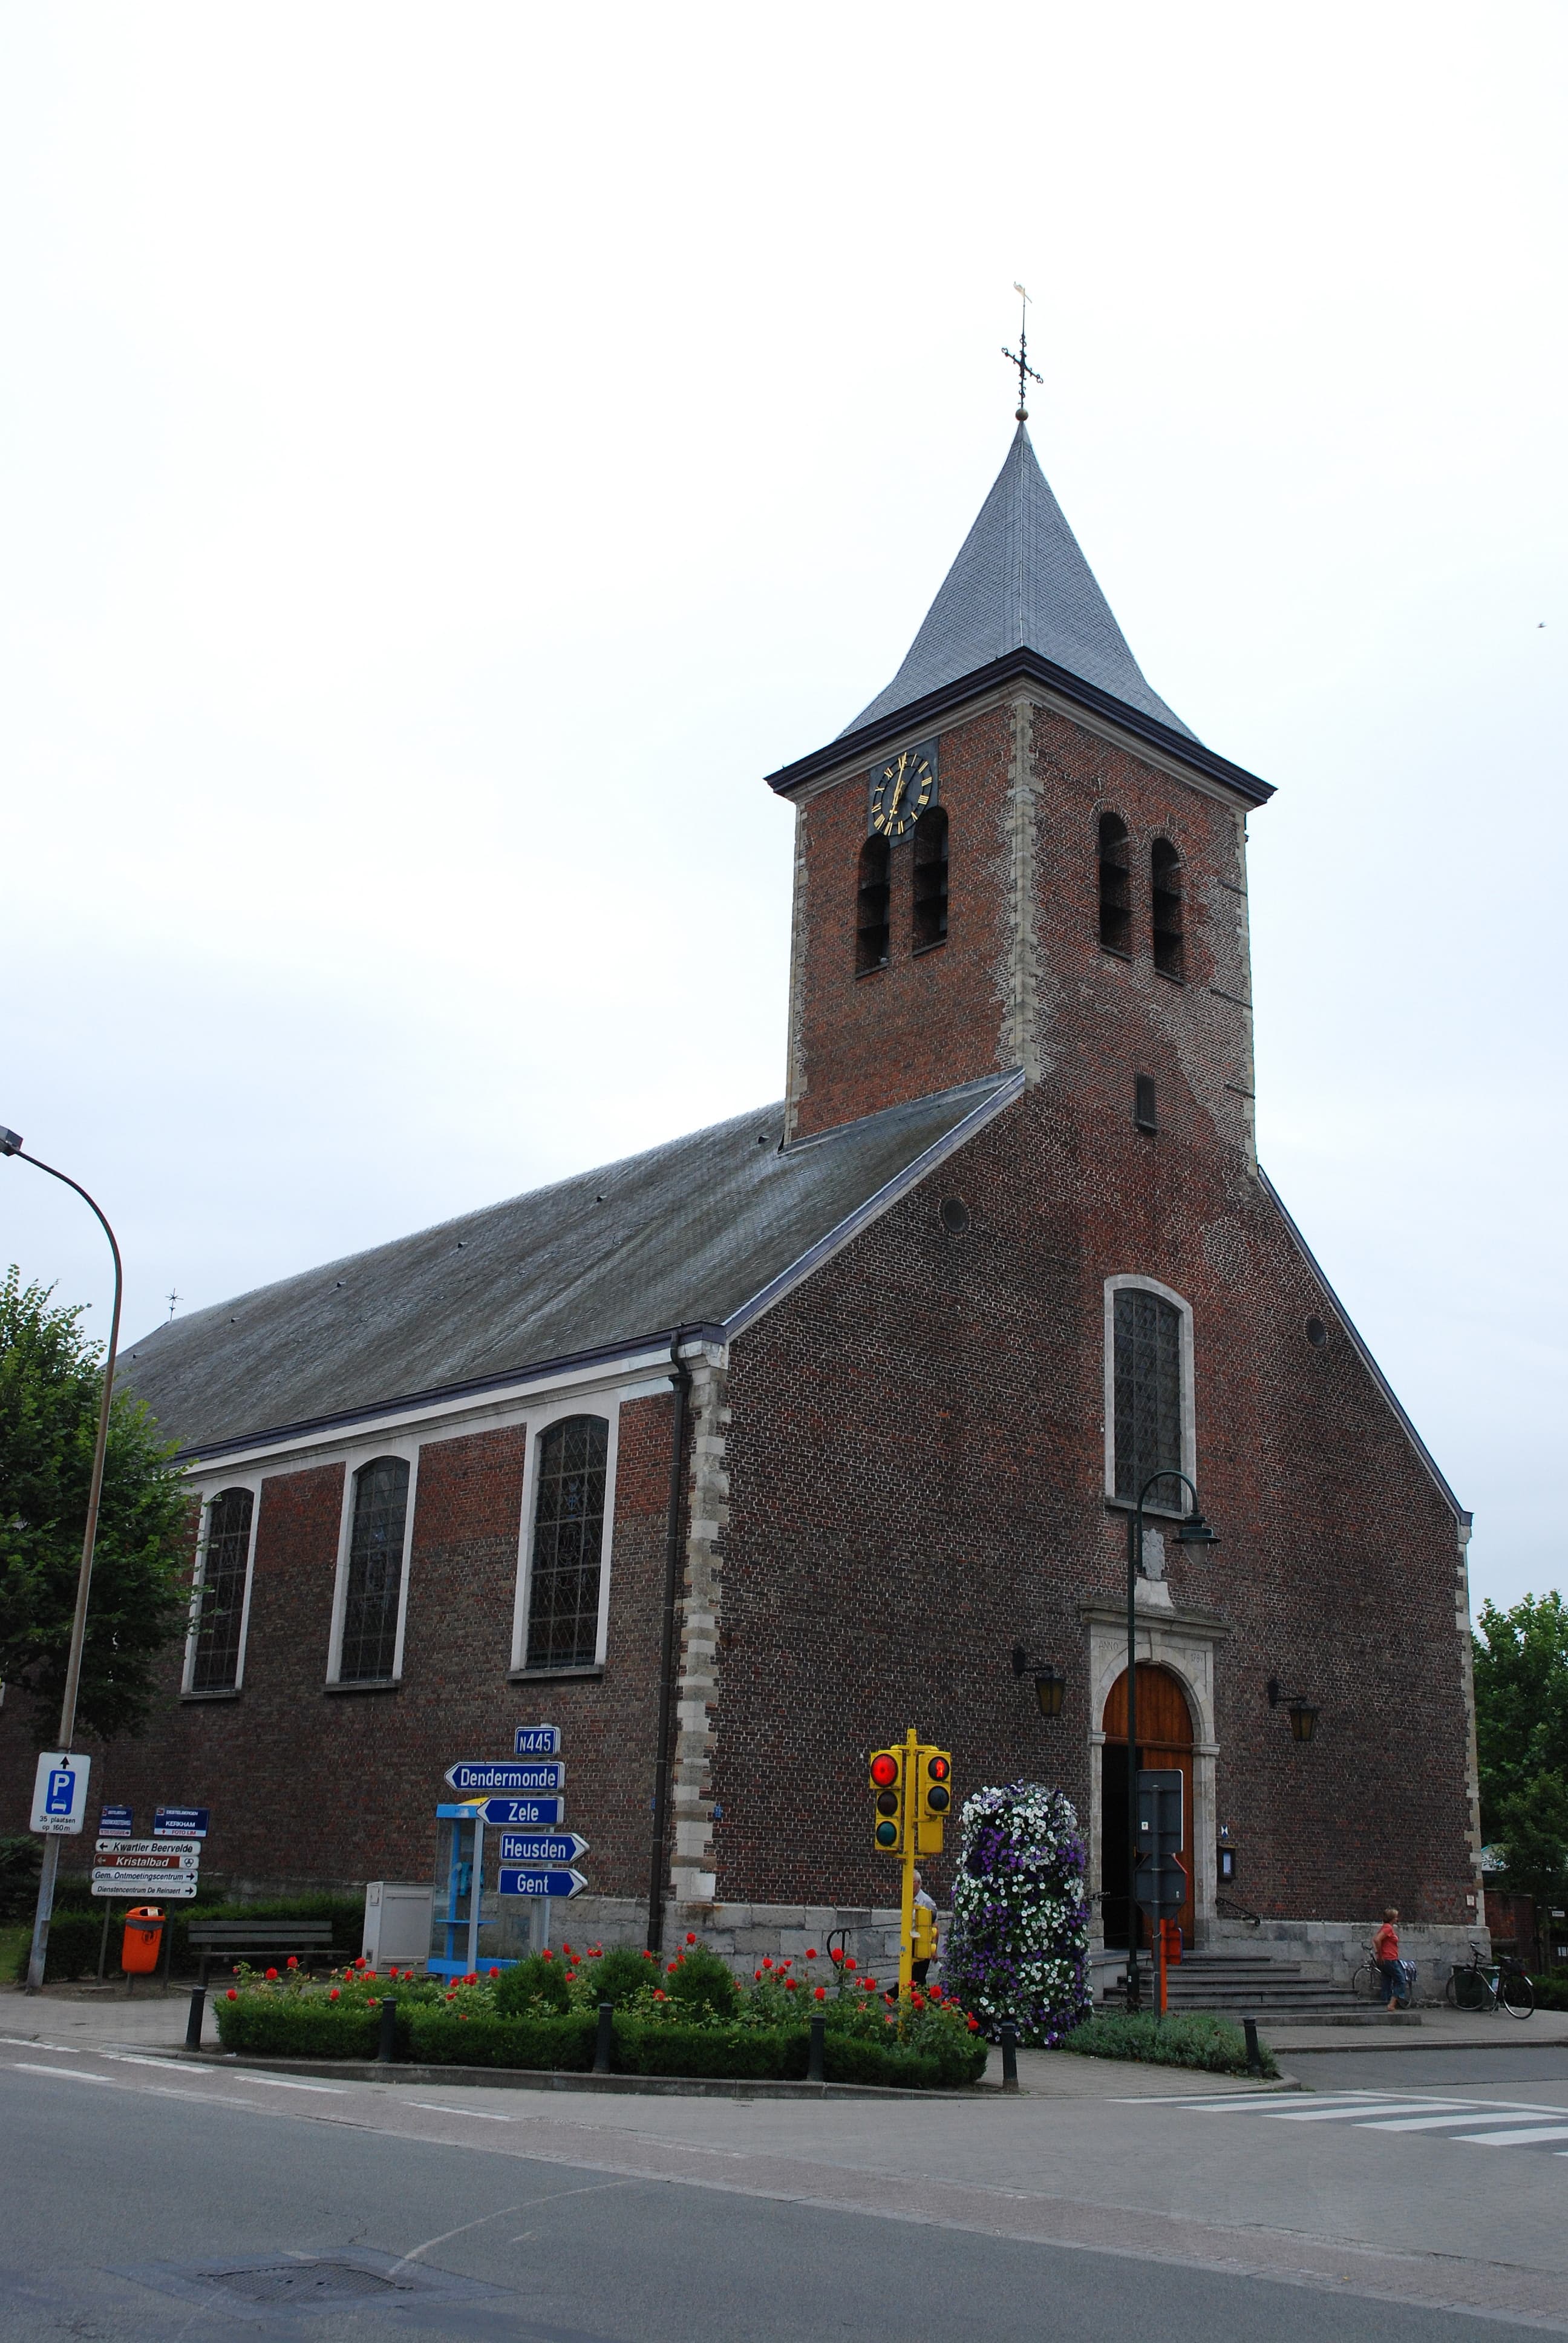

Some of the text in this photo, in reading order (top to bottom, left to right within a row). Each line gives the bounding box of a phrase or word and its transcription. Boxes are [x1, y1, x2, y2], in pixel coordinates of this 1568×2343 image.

[1099, 1640, 1119, 1651] ANNO
[520, 1732, 551, 1752] N445
[53, 1774, 70, 1796] P
[460, 1768, 556, 1786] Dendermonde
[508, 1803, 539, 1821] Zele
[113, 1842, 193, 1853] Kwartier Beervelde
[504, 1838, 566, 1858] Heusden
[116, 1856, 169, 1867] Kristalbad
[114, 1872, 183, 1881] Ontmoetingscentrum
[517, 1873, 549, 1893] Gent
